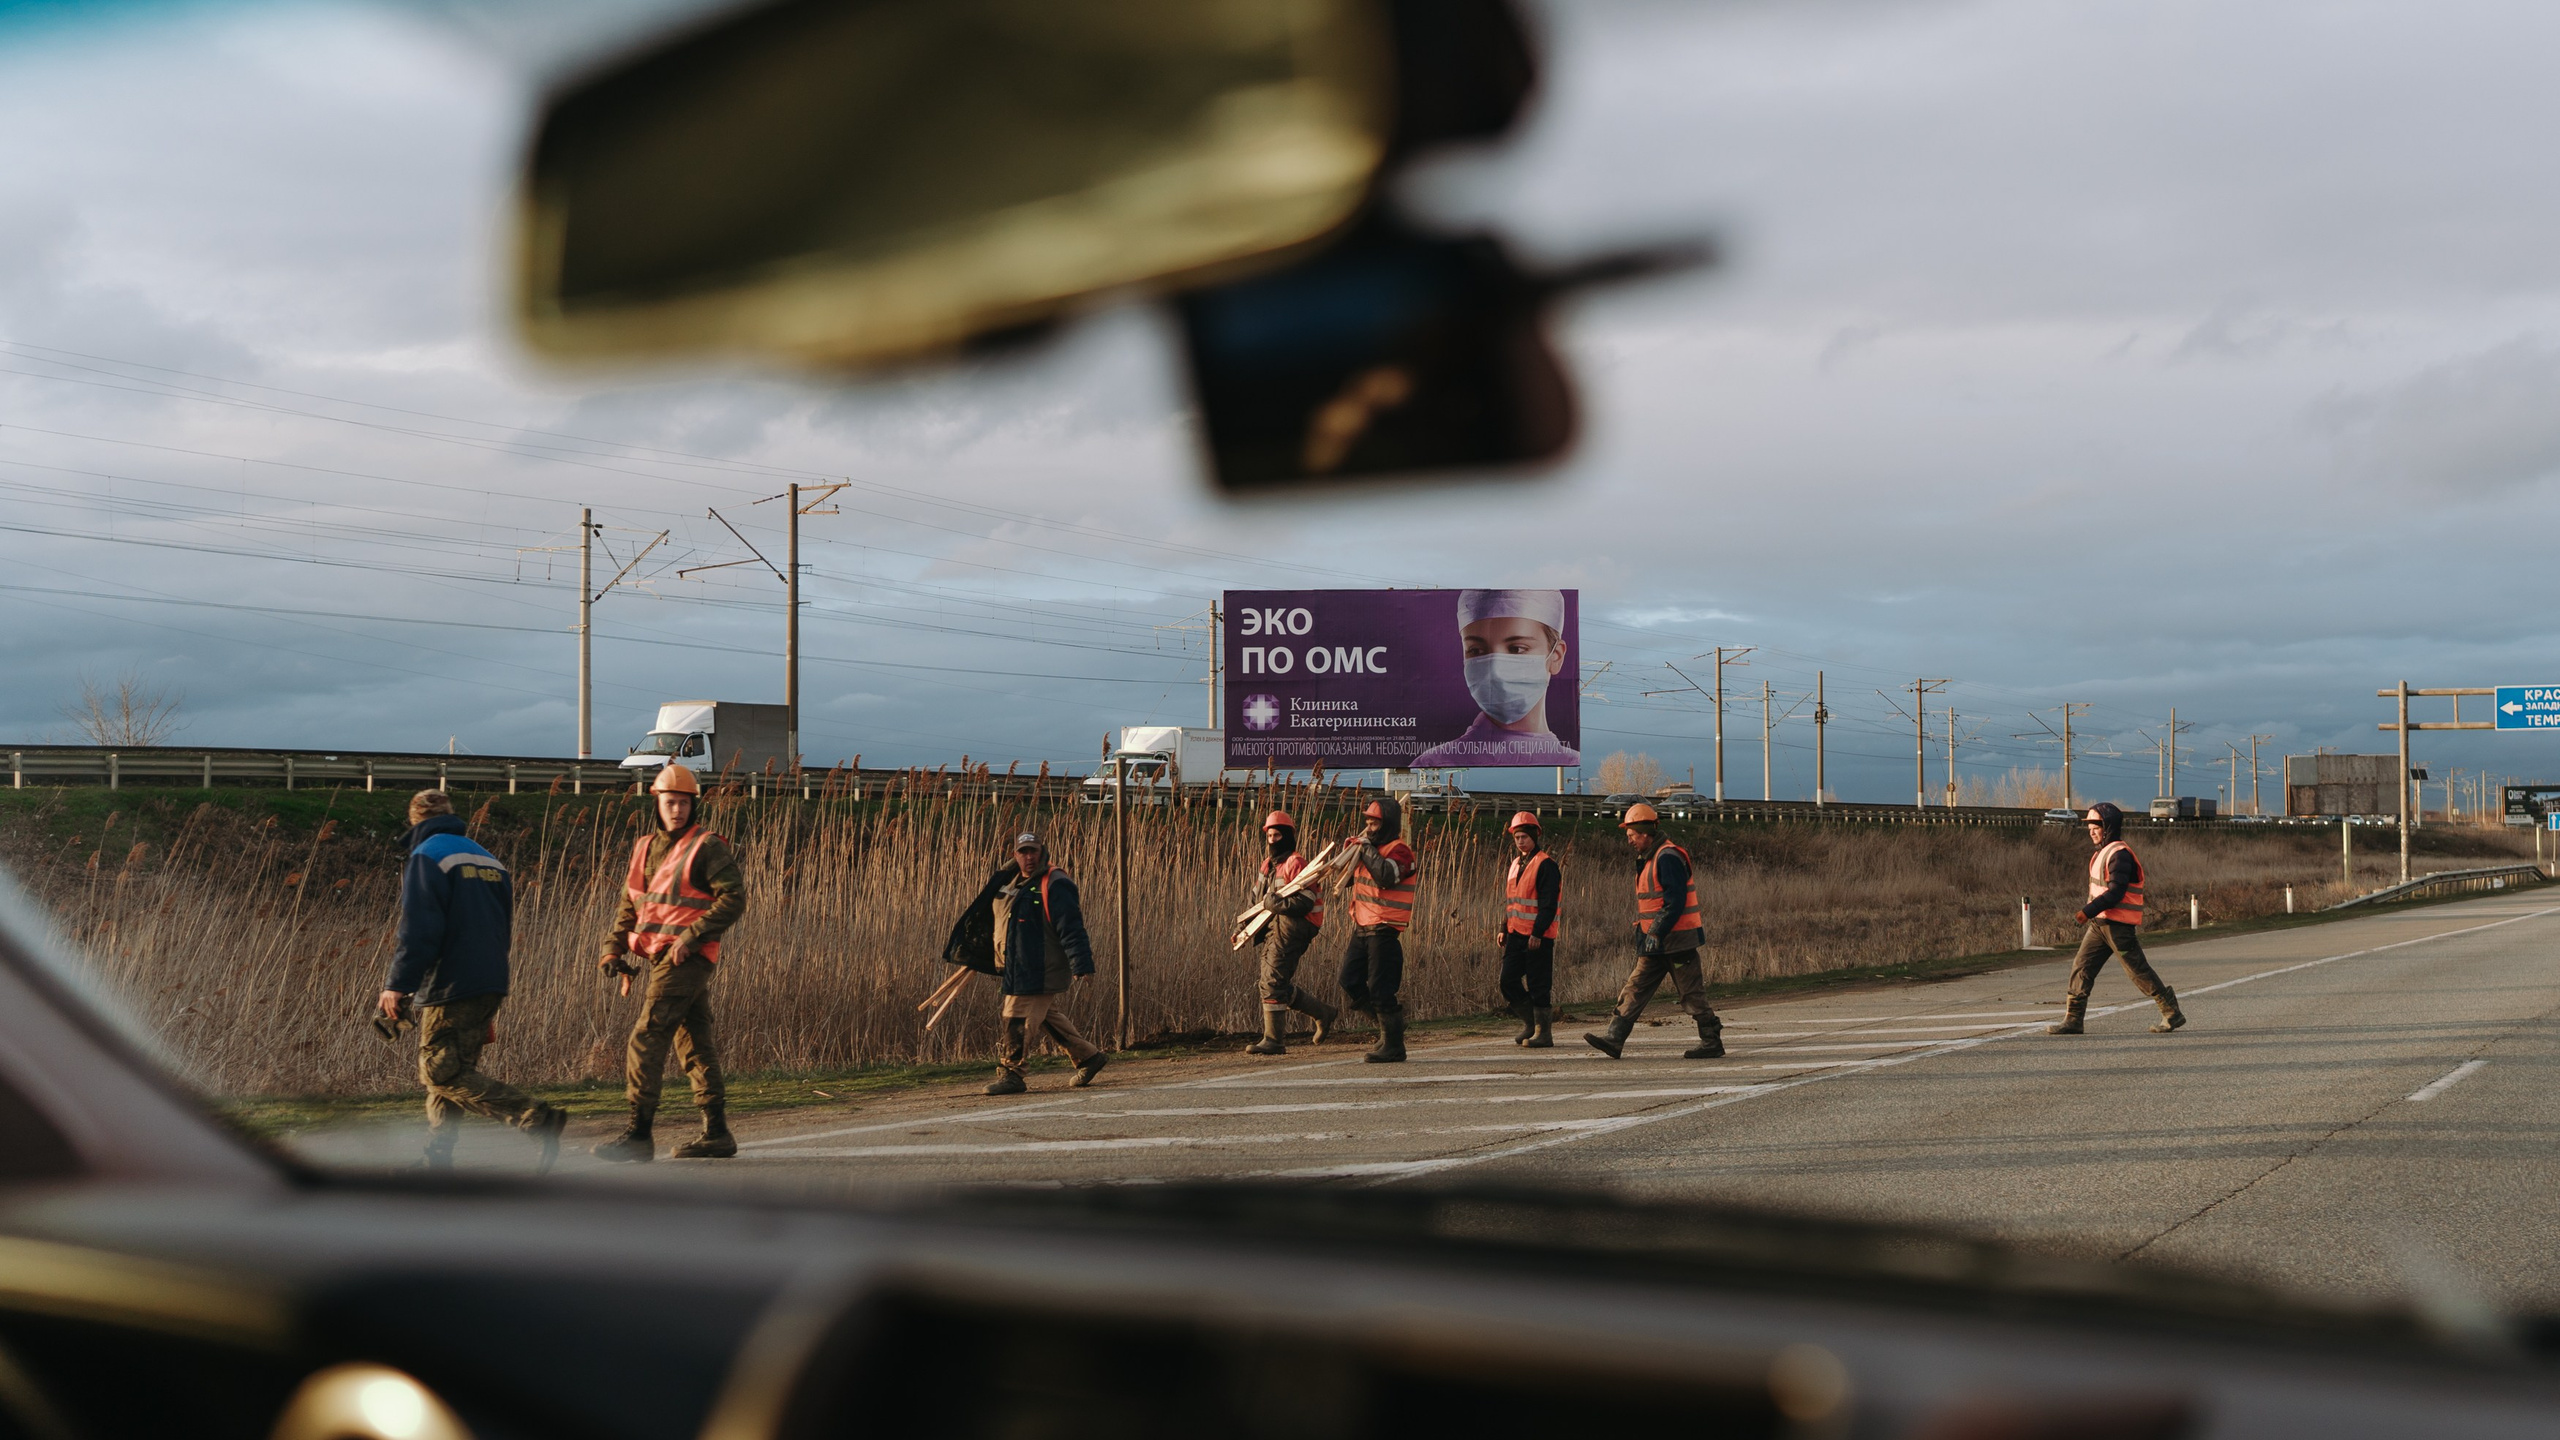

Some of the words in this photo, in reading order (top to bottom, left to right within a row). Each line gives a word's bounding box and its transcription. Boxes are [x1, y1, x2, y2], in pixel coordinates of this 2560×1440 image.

[1240, 607, 1313, 636] ЭКО
[1242, 646, 1294, 674] ПО
[1305, 646, 1388, 674] ОМС
[2524, 689, 2560, 701] КРАС
[1290, 697, 1359, 711] Клиника
[1290, 714, 1417, 732] Екатерининская
[2525, 714, 2560, 726] ТЕМР
[1231, 742, 1275, 756] ИМЕЮТСЯ
[1276, 741, 1374, 756] ПРОТИВОПОКАЗАНИЯ.
[1375, 741, 1438, 757] НЕОБХОДИМА
[1439, 740, 1507, 757] КОНСУЛЬТАЦИЯ
[1508, 740, 1573, 757] СПЕЦИАЛИСТА
